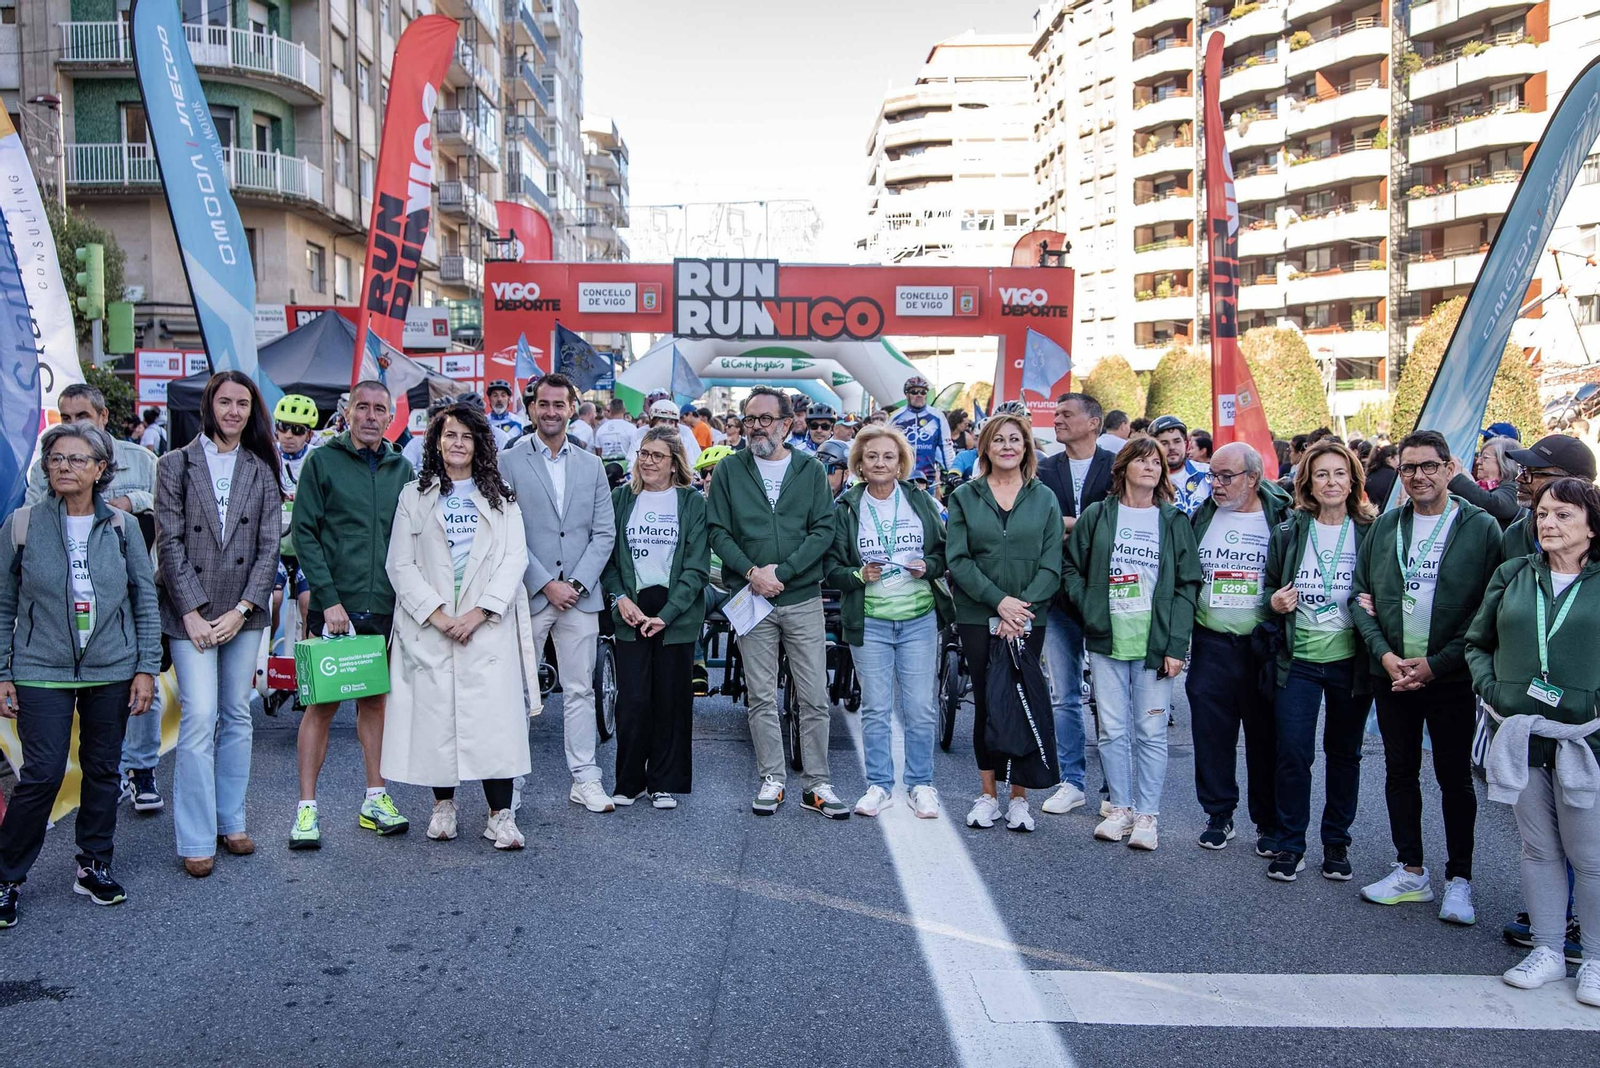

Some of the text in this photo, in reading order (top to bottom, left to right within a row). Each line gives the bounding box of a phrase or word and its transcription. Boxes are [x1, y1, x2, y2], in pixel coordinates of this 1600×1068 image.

[191, 100, 216, 141] MOTOR
[190, 153, 237, 266] OMODA
[9, 175, 49, 290] CONSULTING
[366, 191, 406, 316] RUN
[677, 261, 775, 298] RUN
[1482, 223, 1538, 340] OMODA
[490, 281, 541, 301] VIGO
[582, 288, 631, 298] CONCELLO
[899, 291, 949, 302] CONCELLO
[998, 287, 1048, 306] VIGO
[494, 299, 561, 311] DEPORTE
[588, 298, 626, 306] DE VIGO
[905, 301, 943, 310] DE VIGO
[1001, 304, 1068, 318] DEPORTE
[859, 537, 874, 548] En
[1124, 558, 1149, 567] cáncer
[1216, 547, 1266, 564] March
[1230, 562, 1261, 571] cáncer
[1221, 584, 1249, 594] 5298
